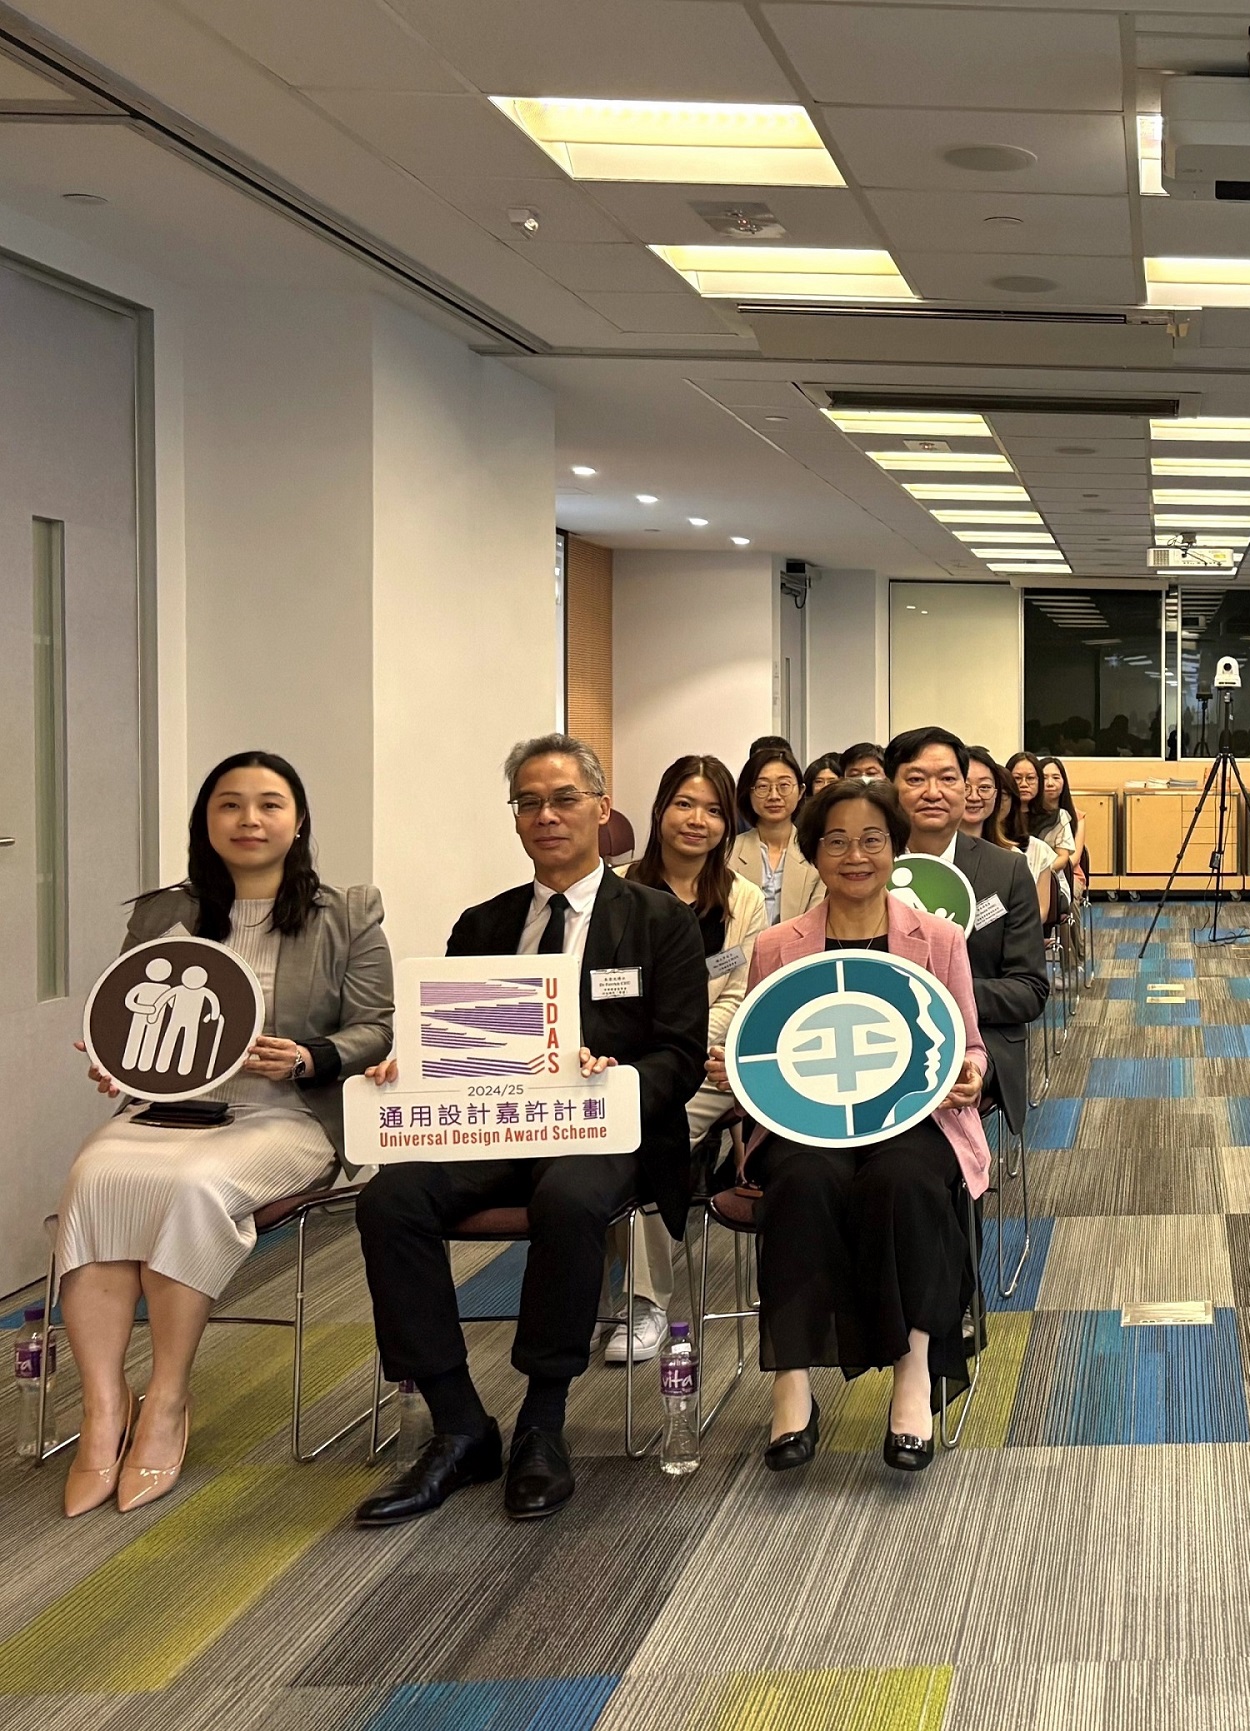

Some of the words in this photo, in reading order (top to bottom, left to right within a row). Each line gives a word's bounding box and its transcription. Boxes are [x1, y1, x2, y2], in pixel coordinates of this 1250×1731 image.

[467, 1084, 524, 1097] 2024/25
[379, 1097, 606, 1129] 通用設計嘉許計劃
[379, 1130, 448, 1148] Universal
[452, 1128, 500, 1147] Design
[505, 1126, 548, 1143] Award
[552, 1124, 607, 1140] Scheme
[662, 1369, 693, 1388] vita
